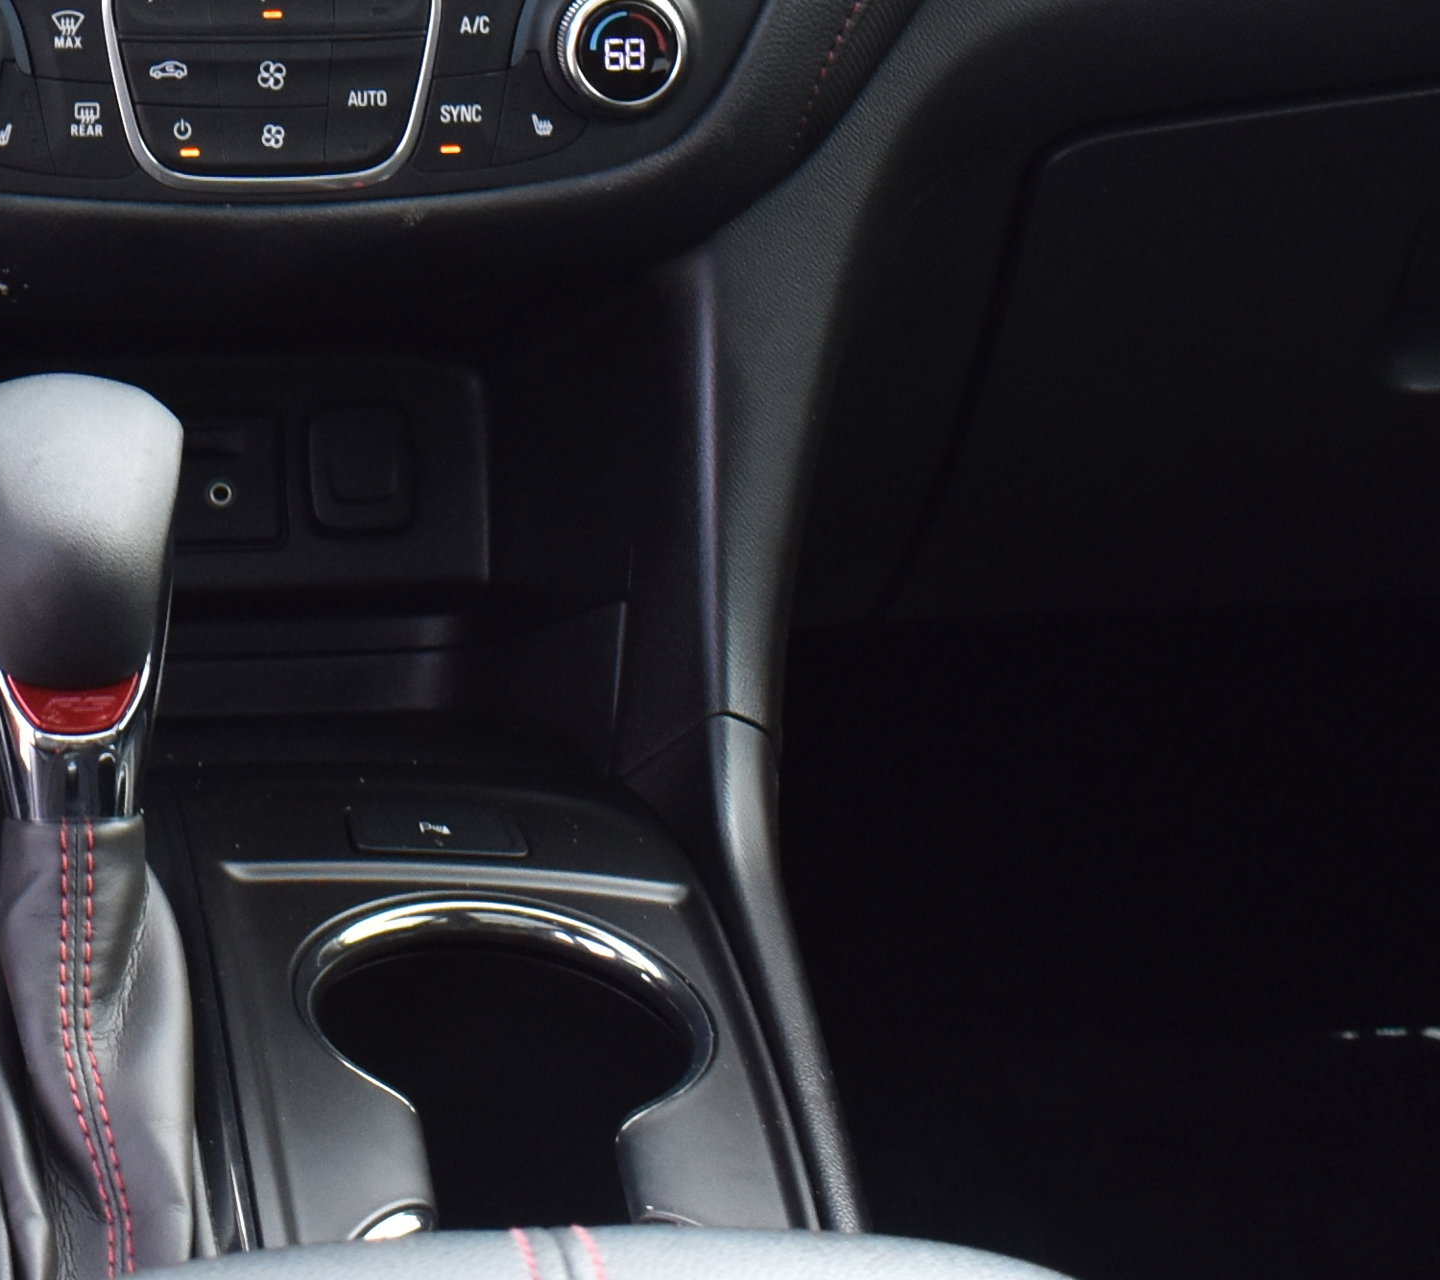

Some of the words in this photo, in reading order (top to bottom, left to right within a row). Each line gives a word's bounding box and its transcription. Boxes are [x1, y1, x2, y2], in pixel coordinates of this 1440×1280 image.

[459, 14, 491, 35] A/C
[53, 36, 83, 49] MAX
[602, 37, 646, 71] 68
[347, 88, 388, 108] AUTO
[439, 103, 483, 124] SYNC
[70, 124, 103, 137] REAR
